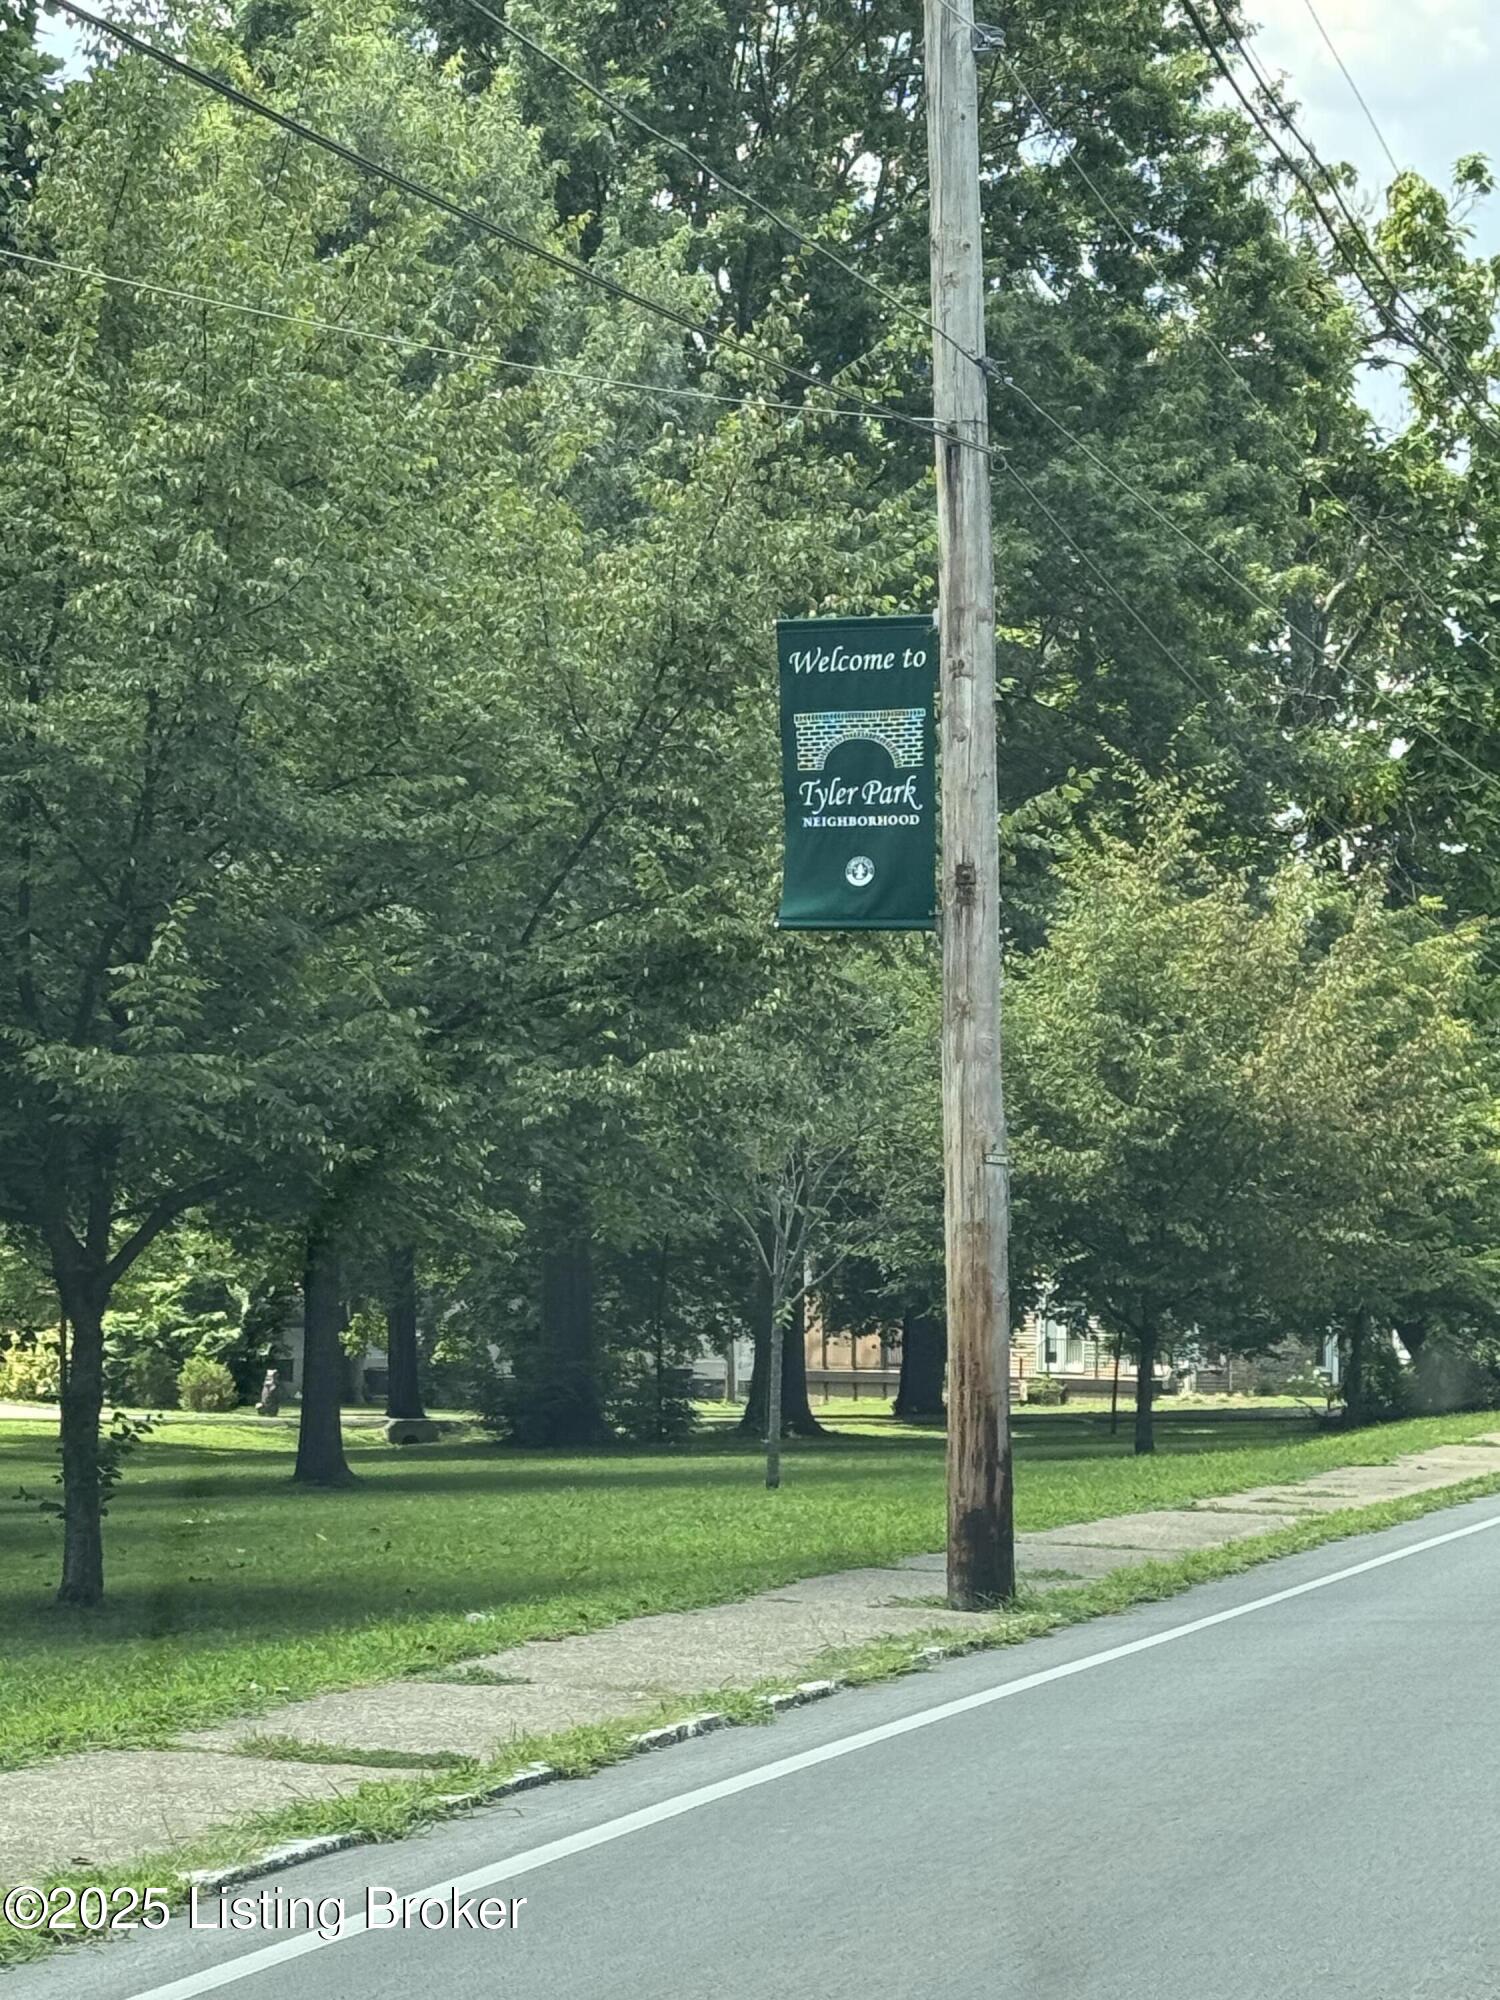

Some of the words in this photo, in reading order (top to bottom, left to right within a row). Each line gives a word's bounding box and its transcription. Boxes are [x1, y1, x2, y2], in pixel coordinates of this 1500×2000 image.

[789, 646, 895, 674] Welcome
[903, 648, 926, 668] to
[799, 777, 858, 815] Tyler
[861, 775, 923, 811] Park
[802, 815, 920, 828] NEIGHBORHOOD
